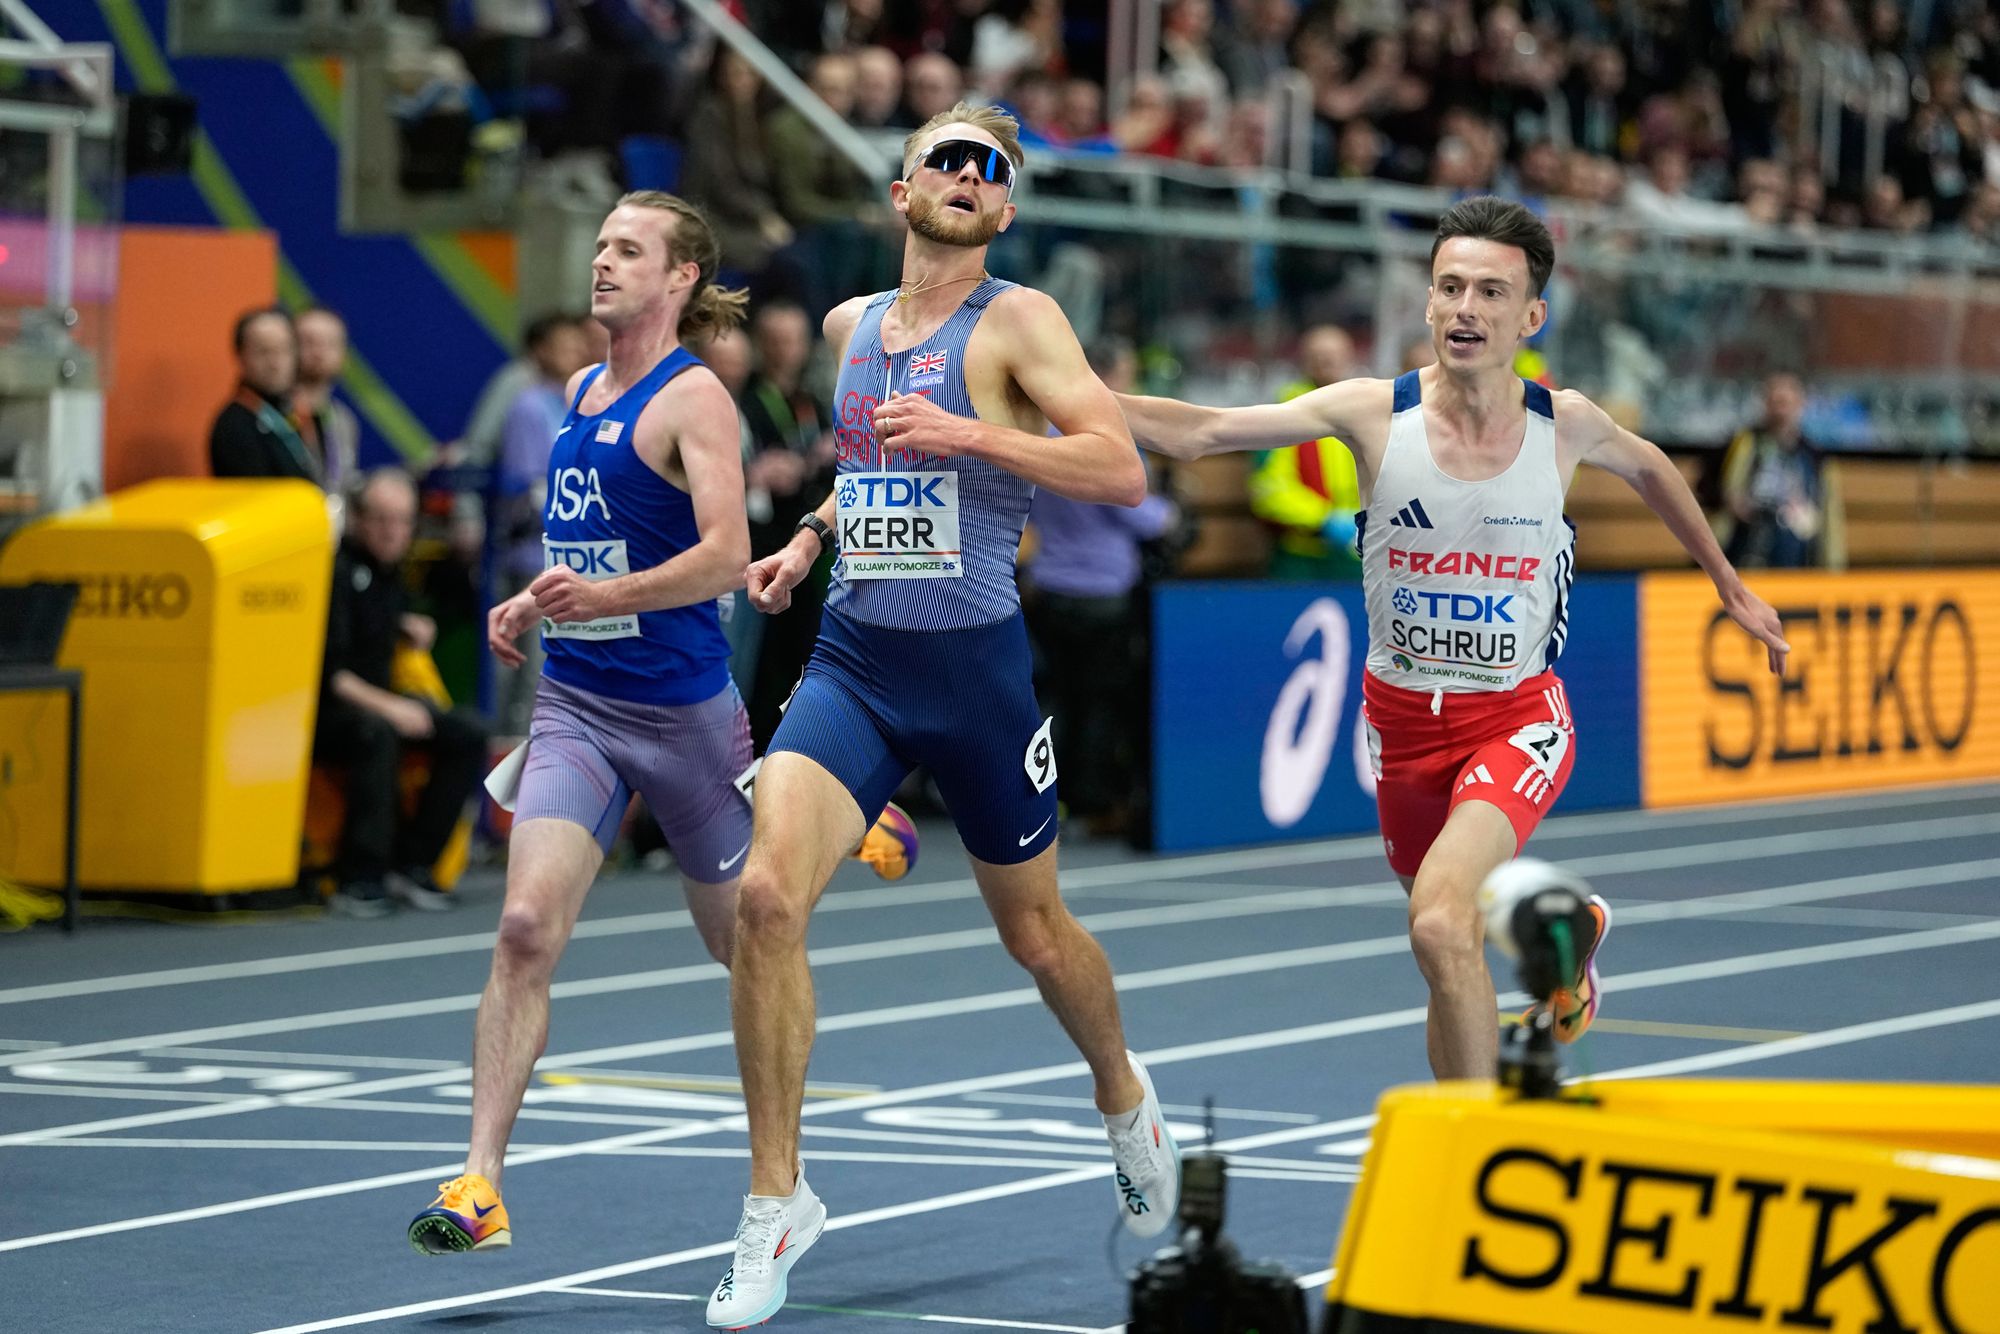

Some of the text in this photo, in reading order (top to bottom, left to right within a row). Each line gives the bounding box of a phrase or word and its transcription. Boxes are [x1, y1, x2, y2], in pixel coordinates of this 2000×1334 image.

[911, 375, 944, 388] Novuna
[858, 477, 946, 507] TDK
[843, 517, 935, 549] KERR
[1484, 516, 1543, 527] Crédit Mutuel
[549, 546, 618, 574] TDK
[854, 562, 891, 572] KUJAWY
[894, 561, 940, 571] POMORZE
[1388, 547, 1541, 582] FRANCE
[1418, 591, 1515, 623] TDK
[1392, 619, 1516, 663] SCHRUB
[1418, 666, 1456, 678] KUJAWY
[1459, 671, 1505, 685] POMORZE
[1702, 600, 1978, 769] SEIKO
[1034, 737, 1049, 784] 9
